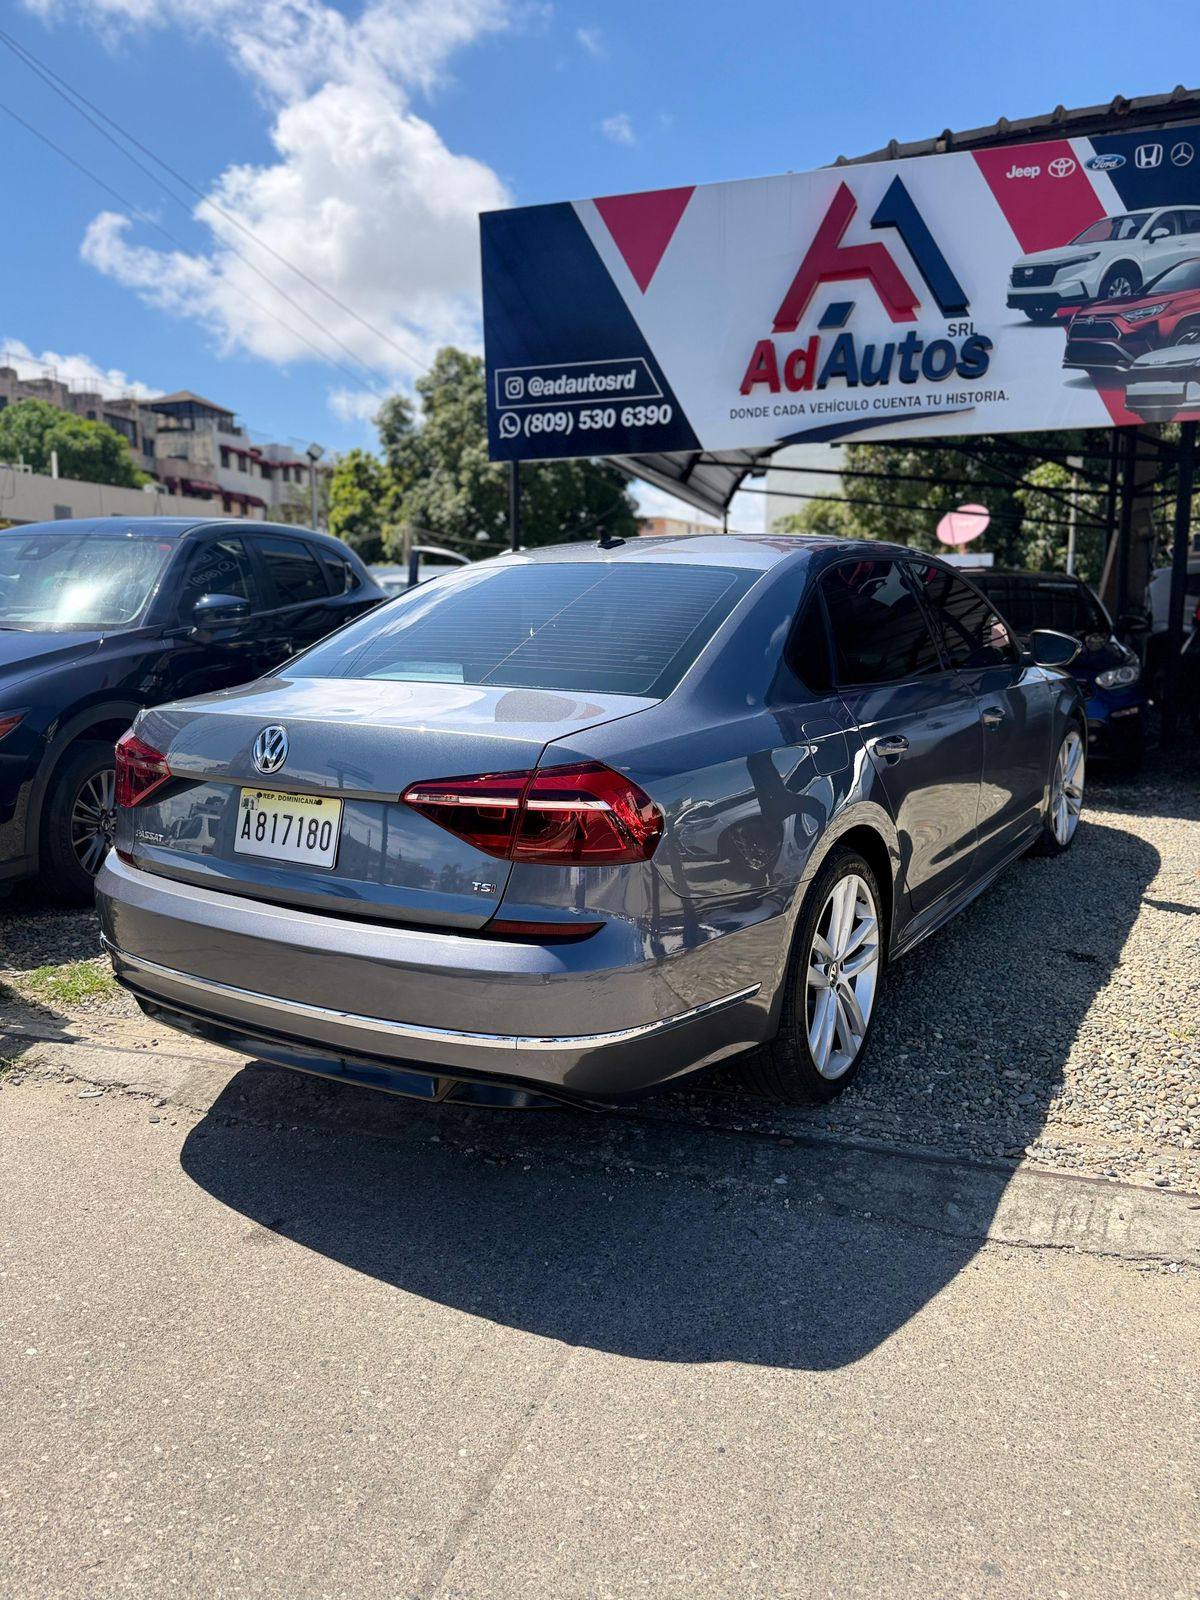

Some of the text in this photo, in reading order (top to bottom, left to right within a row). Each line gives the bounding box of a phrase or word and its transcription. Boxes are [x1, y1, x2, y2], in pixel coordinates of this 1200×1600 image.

[1006, 165, 1041, 179] Jeep
[1091, 156, 1119, 170] Ford
[947, 322, 978, 337] SRL
[739, 330, 993, 395] AdAutos
[527, 369, 636, 397] @adautosrd
[730, 390, 1010, 419] DONDE CADA VEHÍCULO CUENTA TU HISTORIA.
[523, 404, 672, 438] (809) 530 6390
[278, 795, 318, 805] DOMINICANA
[240, 810, 332, 851] A817180
